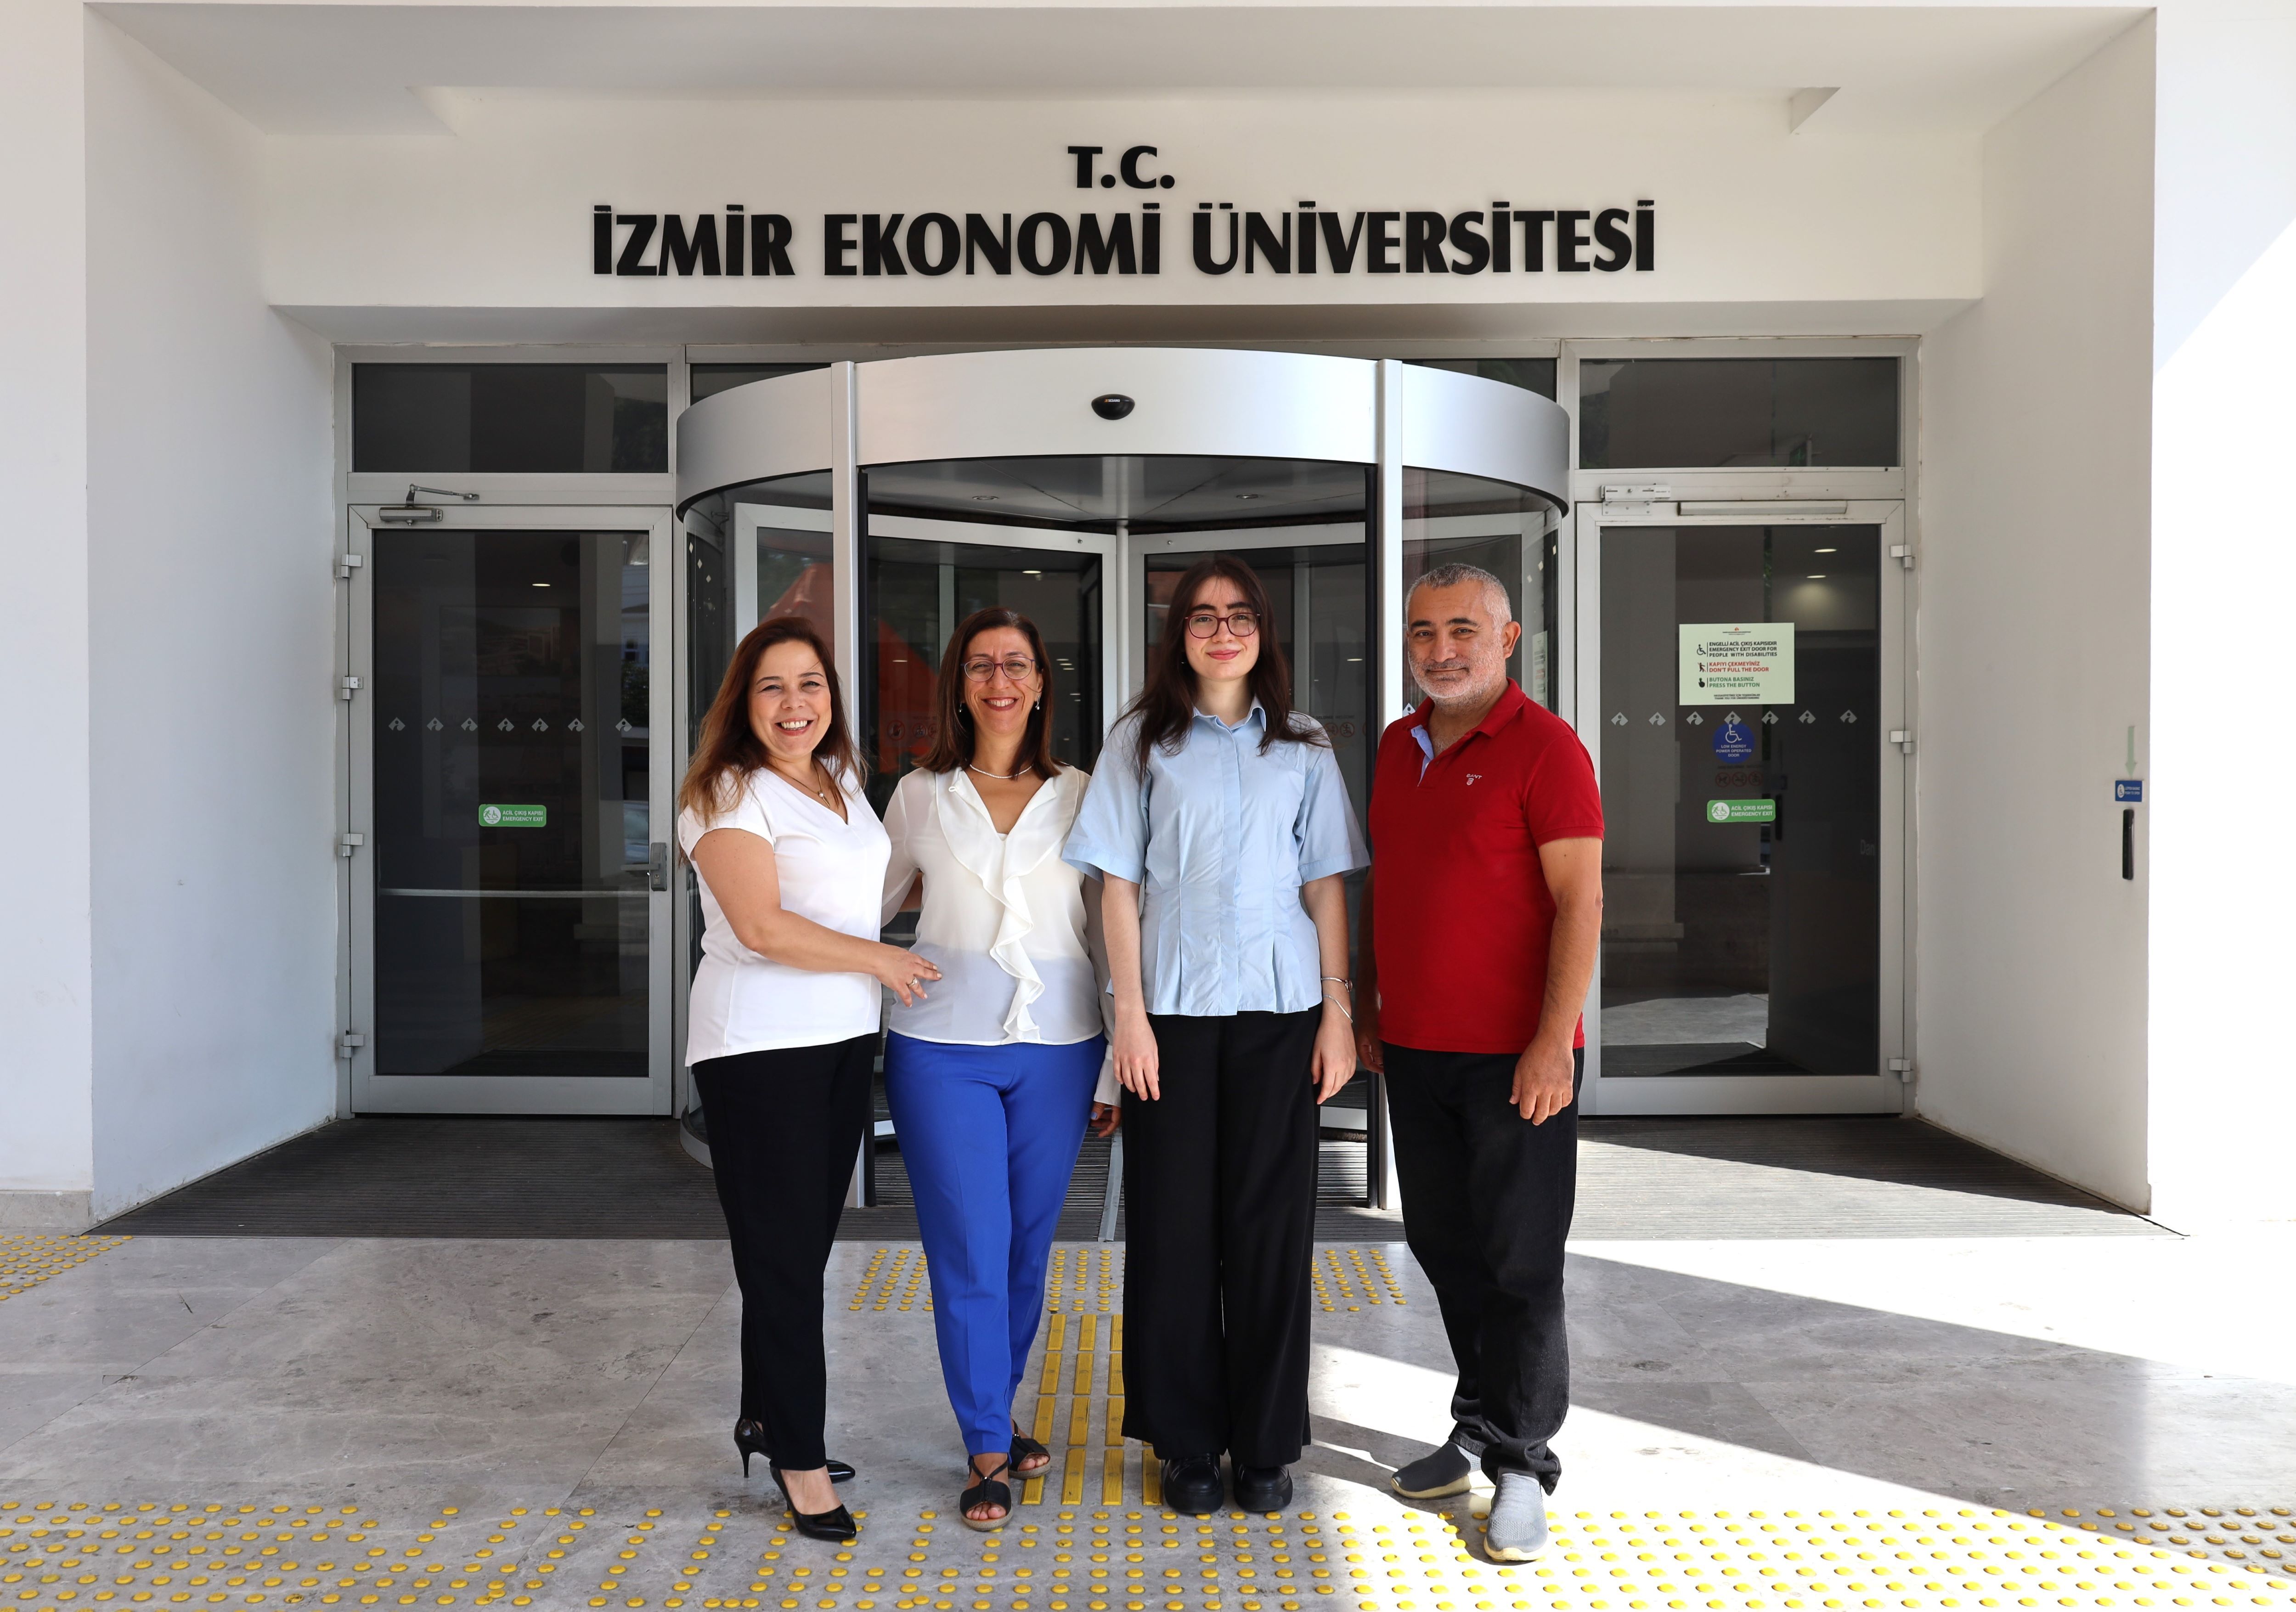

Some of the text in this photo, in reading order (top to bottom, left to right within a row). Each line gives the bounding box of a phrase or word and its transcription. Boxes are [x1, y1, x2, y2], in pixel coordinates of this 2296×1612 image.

[1068, 146, 1175, 189] T.C.
[594, 200, 1654, 276] İZMİR EKONOMİ ÜNİVERSİTESİ
